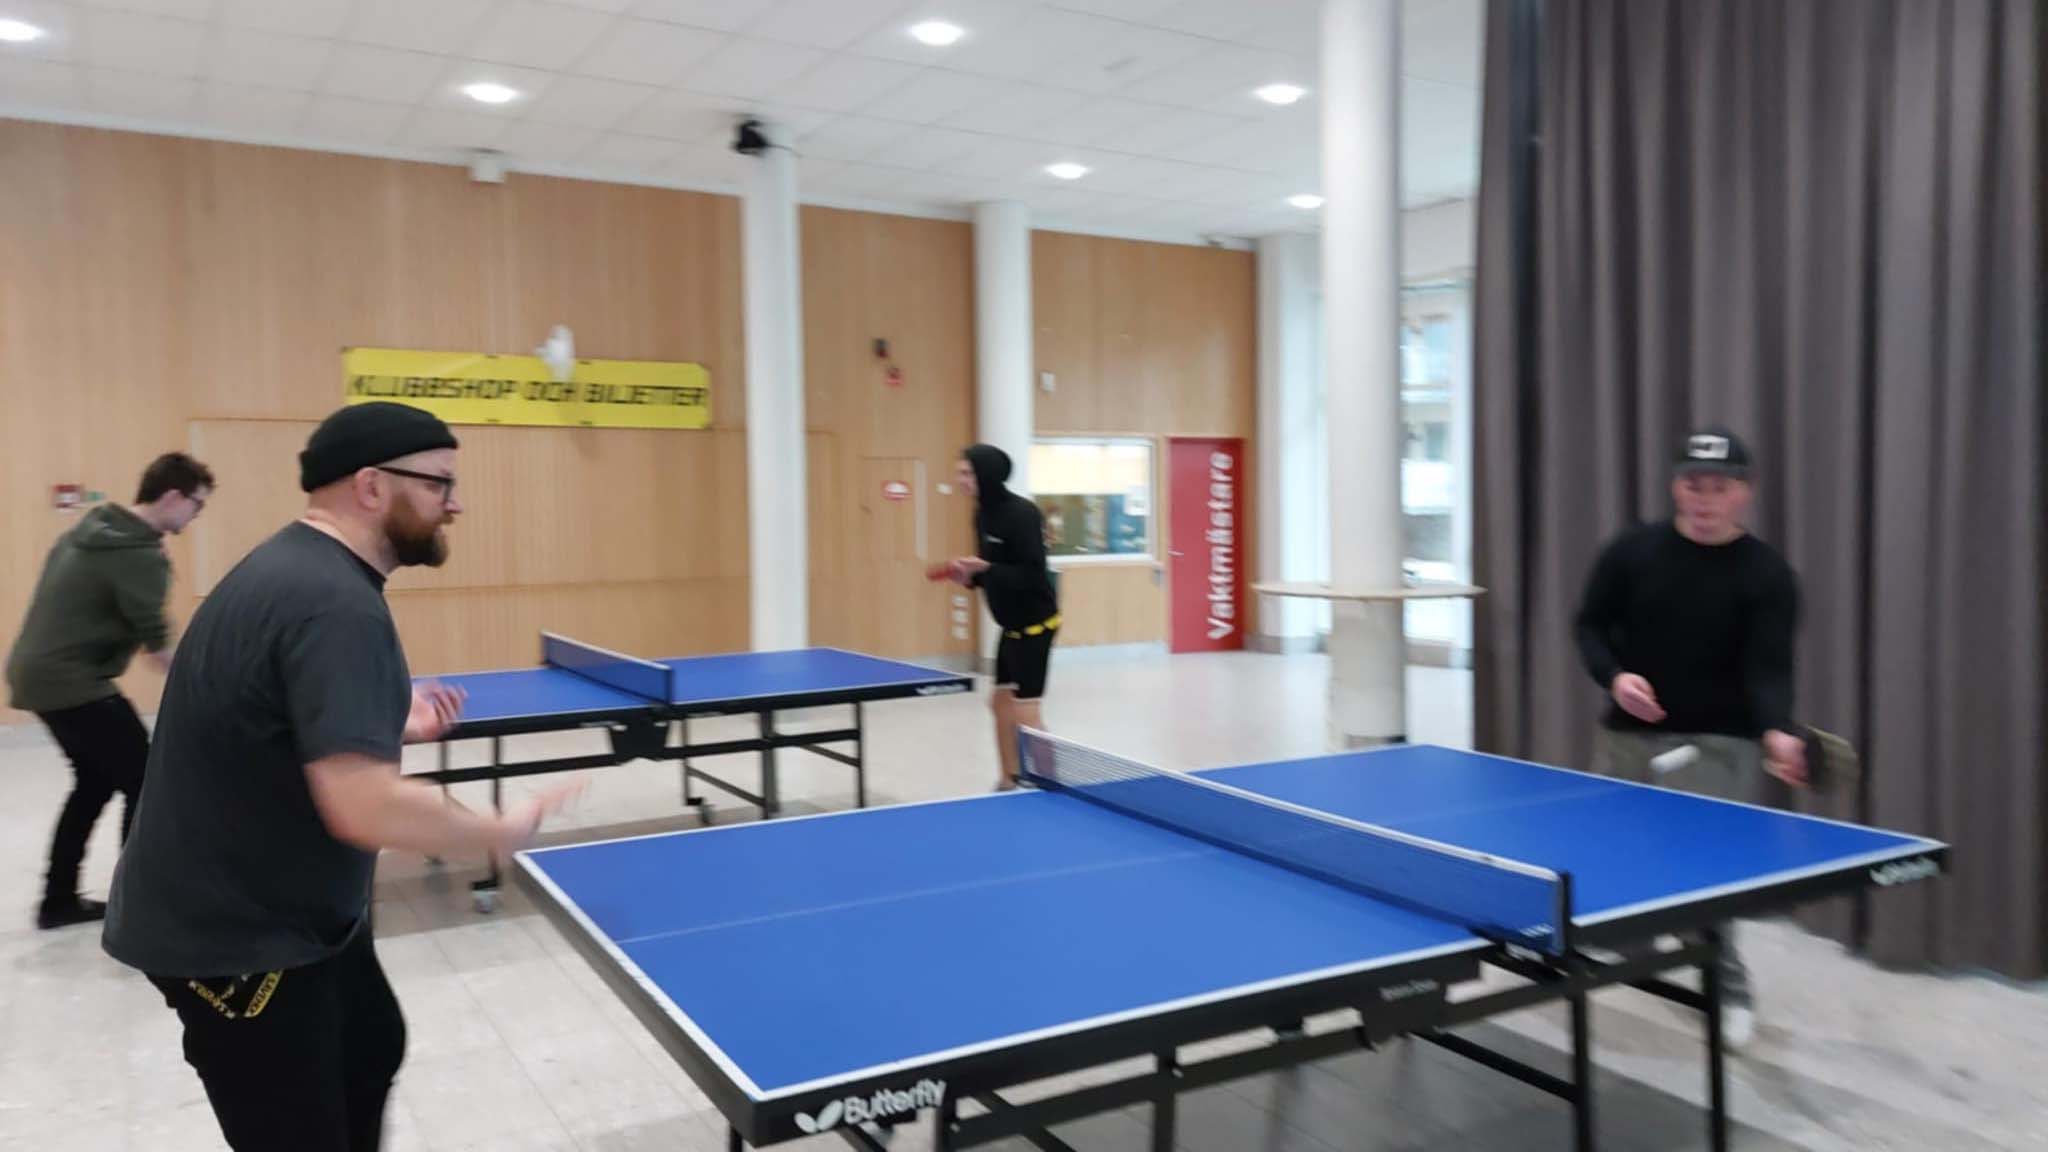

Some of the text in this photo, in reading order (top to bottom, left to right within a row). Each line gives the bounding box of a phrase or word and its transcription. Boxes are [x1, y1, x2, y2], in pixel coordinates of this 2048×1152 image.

[350, 375, 707, 406] KLUBBSHOP OCH BILJETTER
[1205, 451, 1235, 640] Vaktmästare
[844, 1078, 947, 1125] Butterfly
